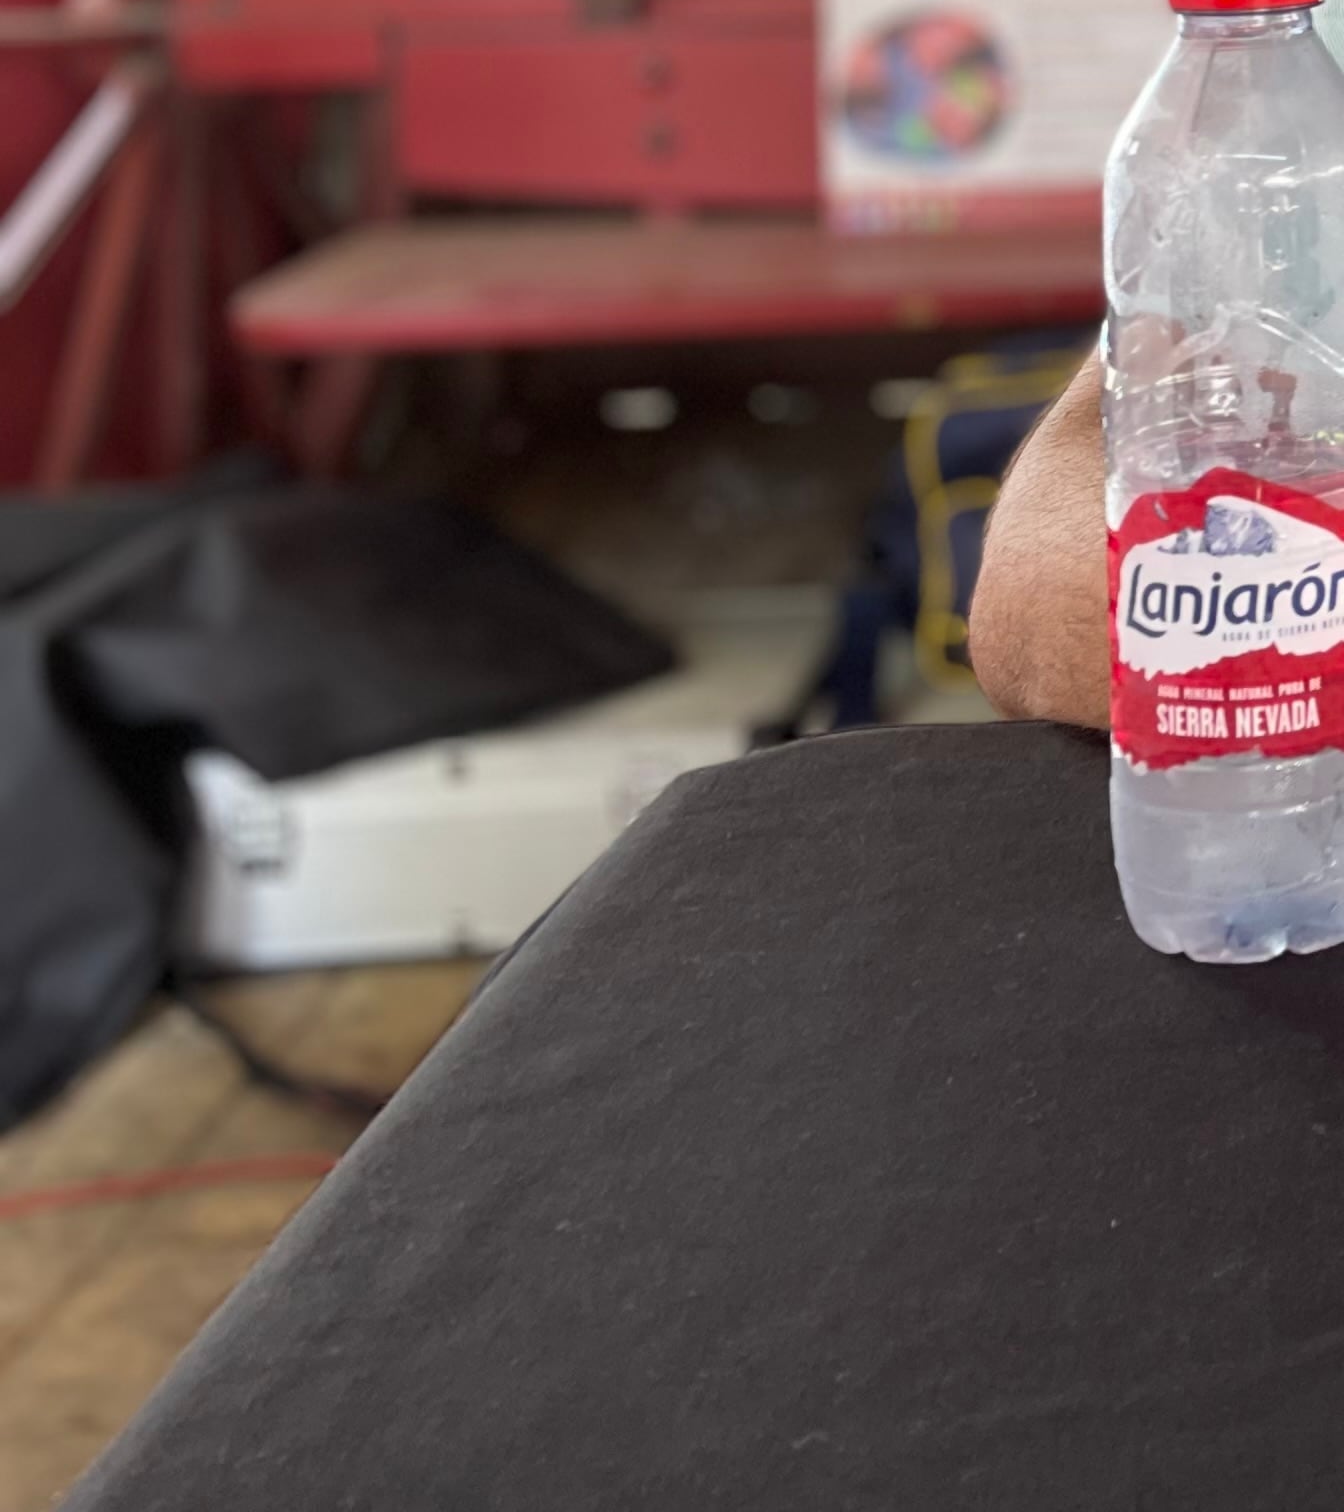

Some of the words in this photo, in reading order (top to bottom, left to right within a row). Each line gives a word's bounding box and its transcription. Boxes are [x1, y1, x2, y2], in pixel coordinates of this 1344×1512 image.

[1183, 686, 1225, 701] MINERAL
[1229, 685, 1275, 701] NATURAL
[1156, 703, 1229, 738] SIERRA
[1235, 697, 1320, 738] NEVADA
